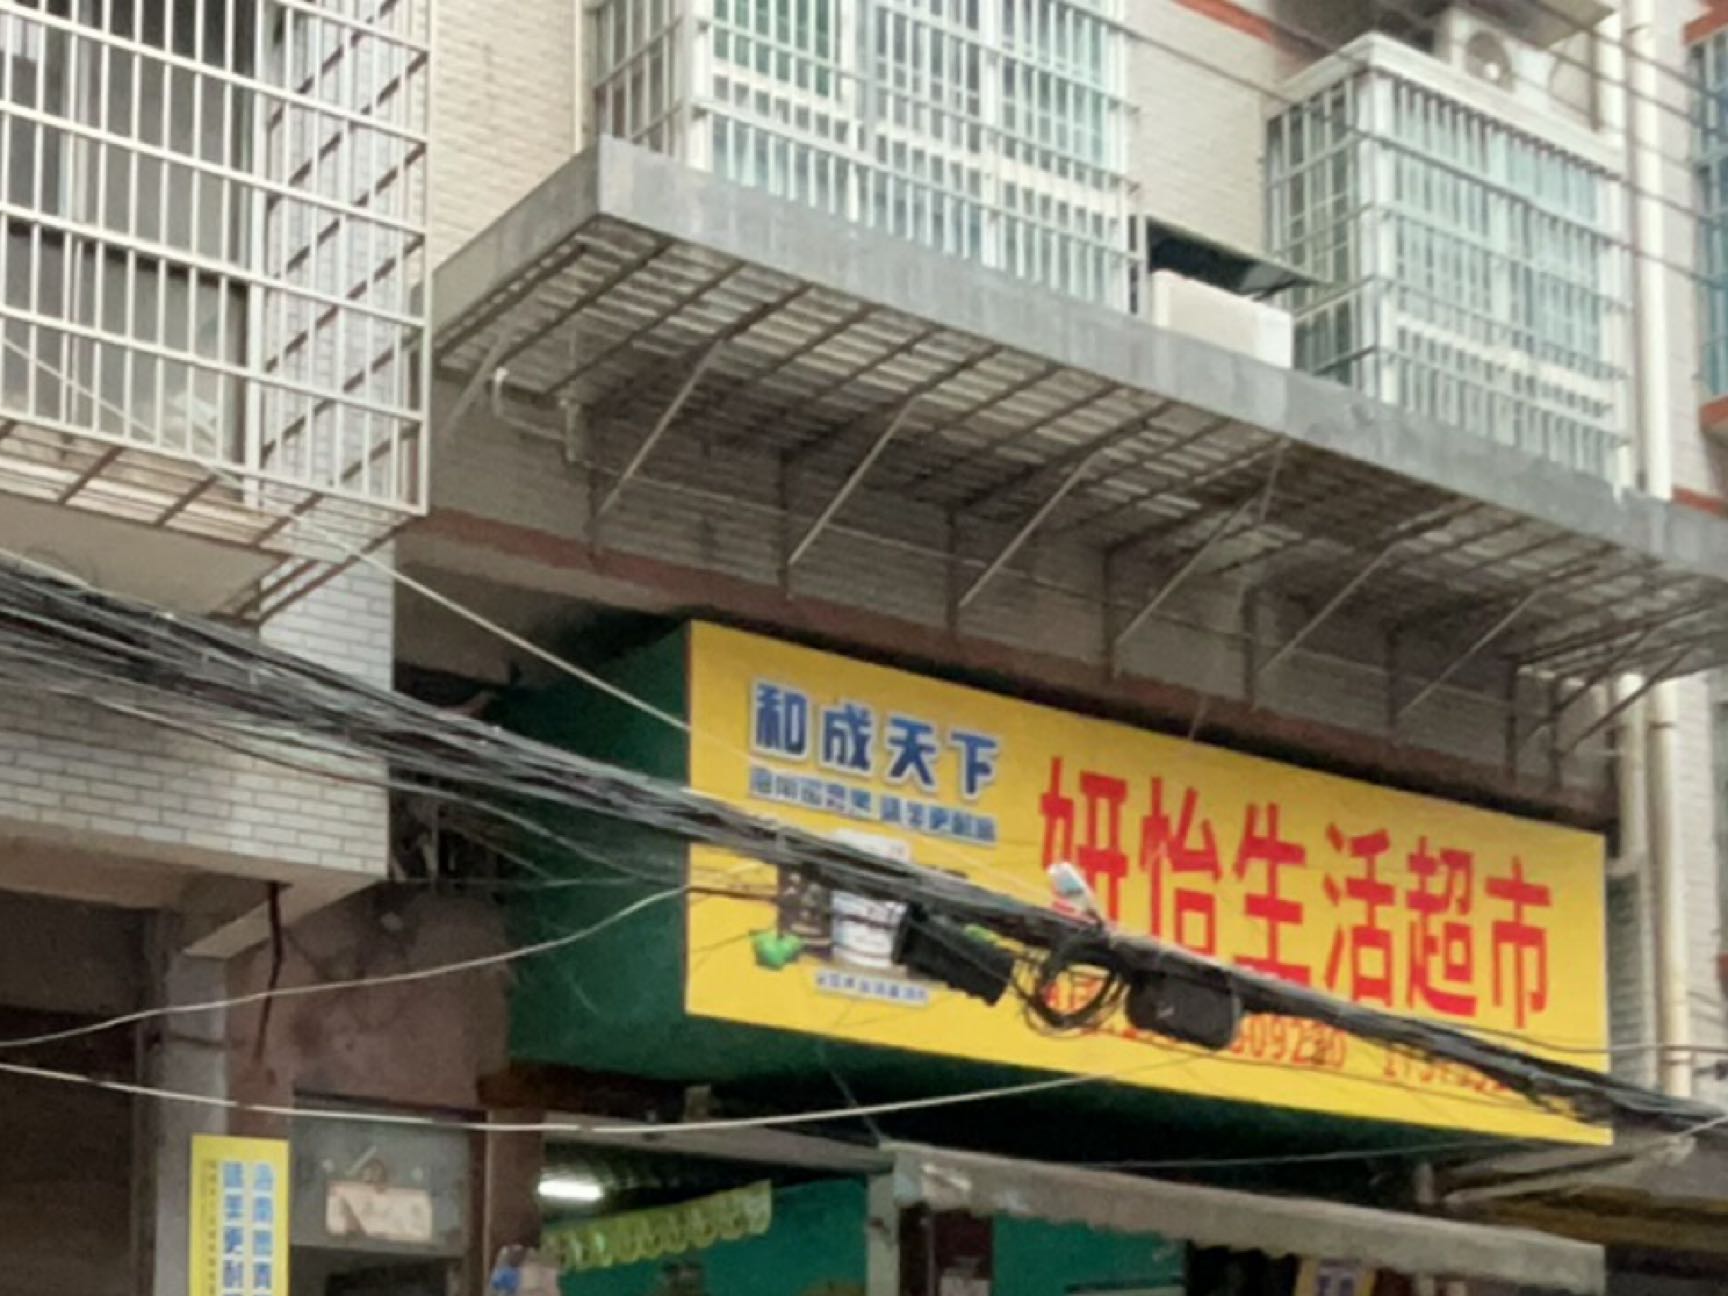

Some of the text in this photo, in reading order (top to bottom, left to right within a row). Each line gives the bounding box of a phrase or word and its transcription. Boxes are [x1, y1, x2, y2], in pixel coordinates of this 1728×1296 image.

[753, 680, 999, 797] 和成天下
[1039, 756, 1552, 1029] 妍怡生活超市
